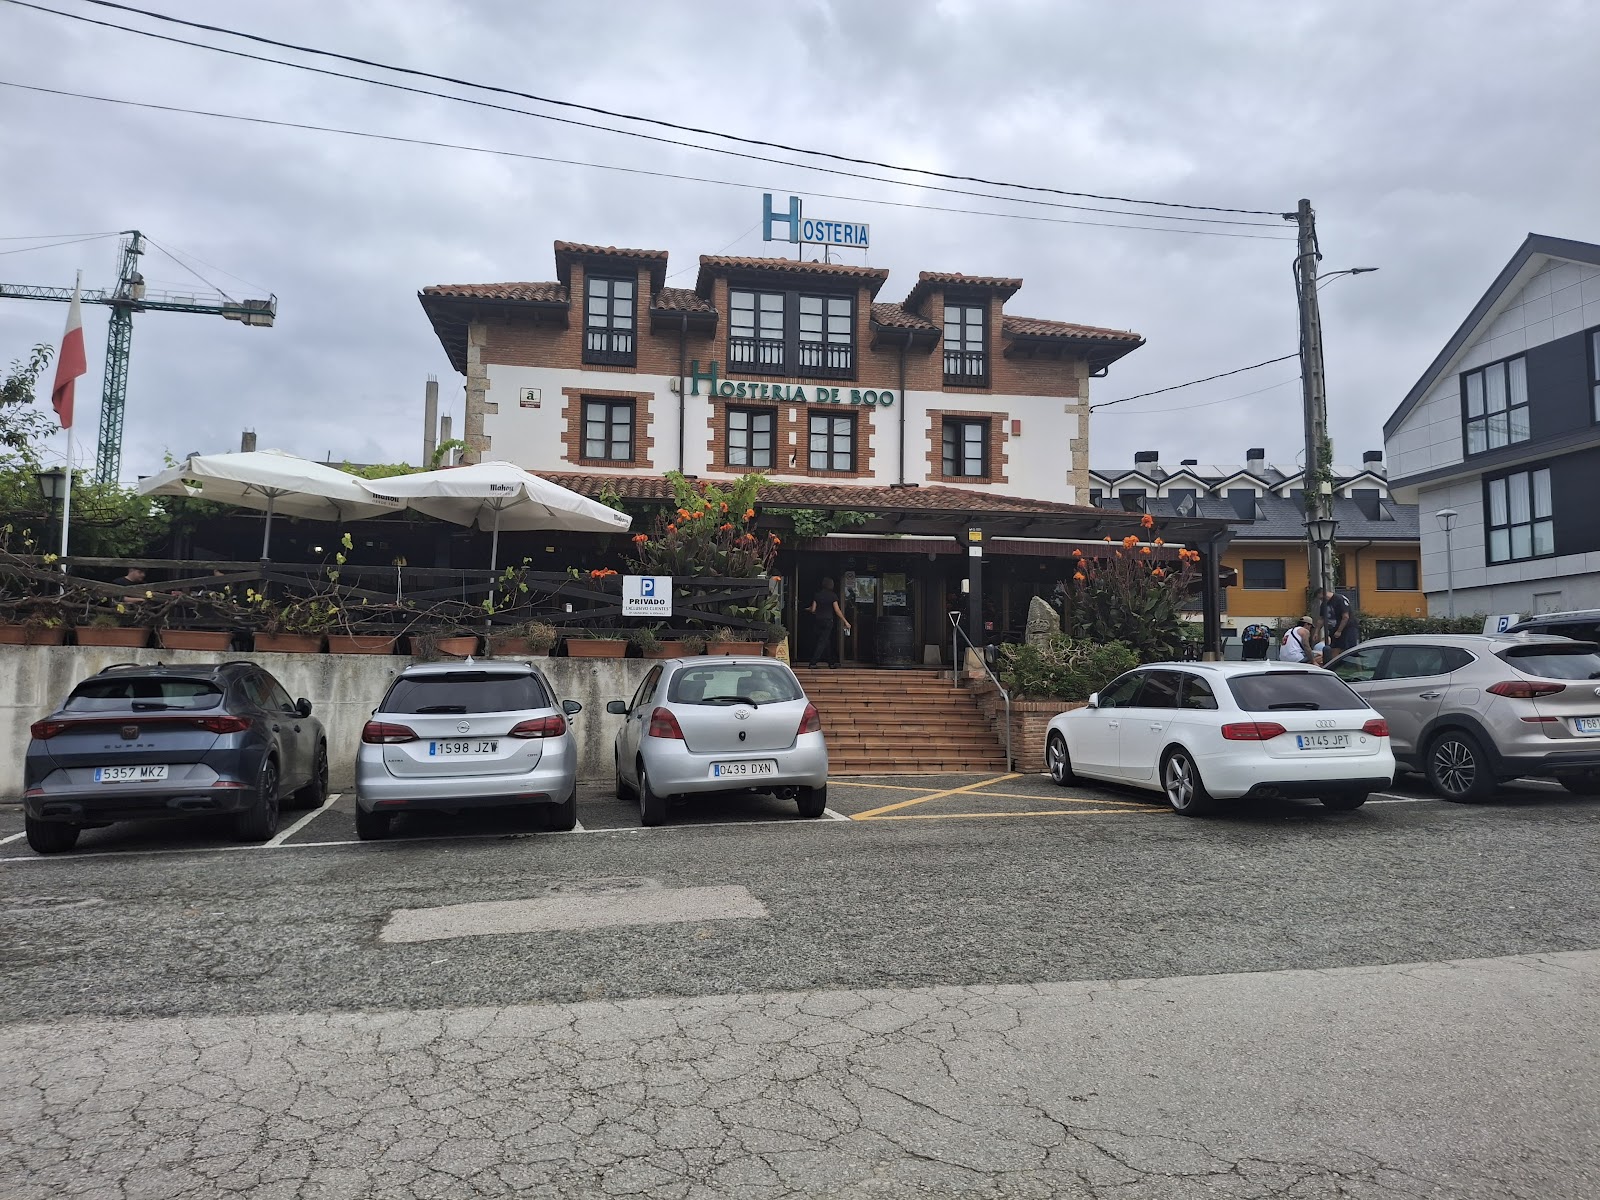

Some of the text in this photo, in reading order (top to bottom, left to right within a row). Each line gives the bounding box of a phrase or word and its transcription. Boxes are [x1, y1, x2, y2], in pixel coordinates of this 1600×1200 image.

[691, 360, 894, 406] HOSTERIA DE BOO
[1304, 735, 1349, 746] 3145 JPT
[440, 742, 498, 754] 1598 JZW
[104, 766, 164, 779] 5357 MKZ
[720, 763, 771, 774] 0439 DXN
